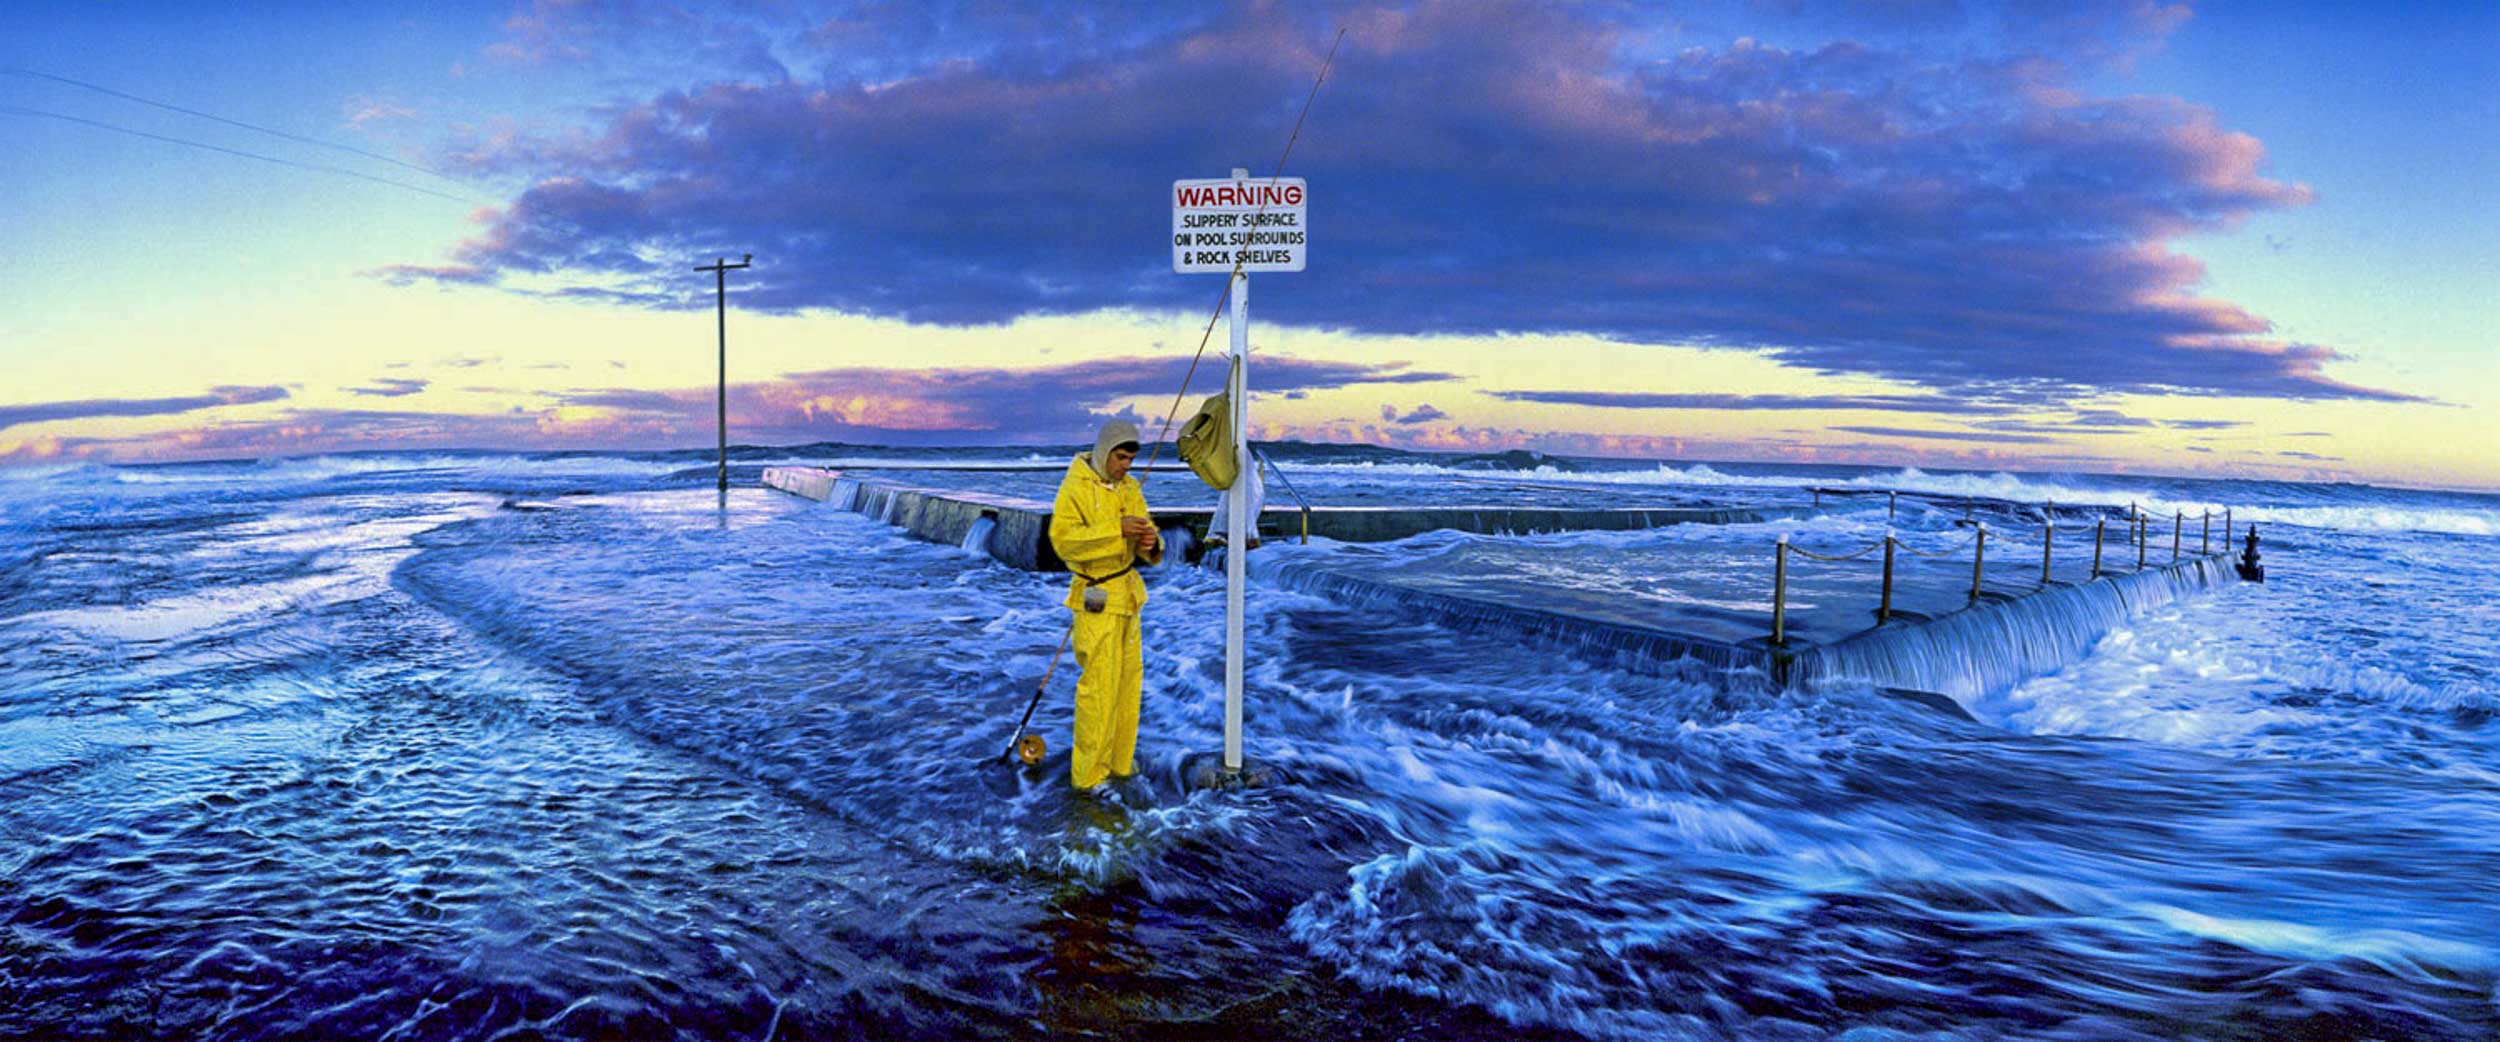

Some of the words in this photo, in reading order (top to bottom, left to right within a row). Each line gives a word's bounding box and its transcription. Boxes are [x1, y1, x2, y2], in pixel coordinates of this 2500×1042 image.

[1177, 186, 1303, 207] WARNING
[1183, 214, 1239, 228] SLIPPERY
[1174, 233, 1192, 246] ON
[1196, 233, 1228, 246] POOL
[1229, 232, 1304, 245] SURROUNDS
[1183, 252, 1192, 264] &
[1196, 251, 1230, 264] ROCK
[1235, 250, 1291, 263] SHELVES
